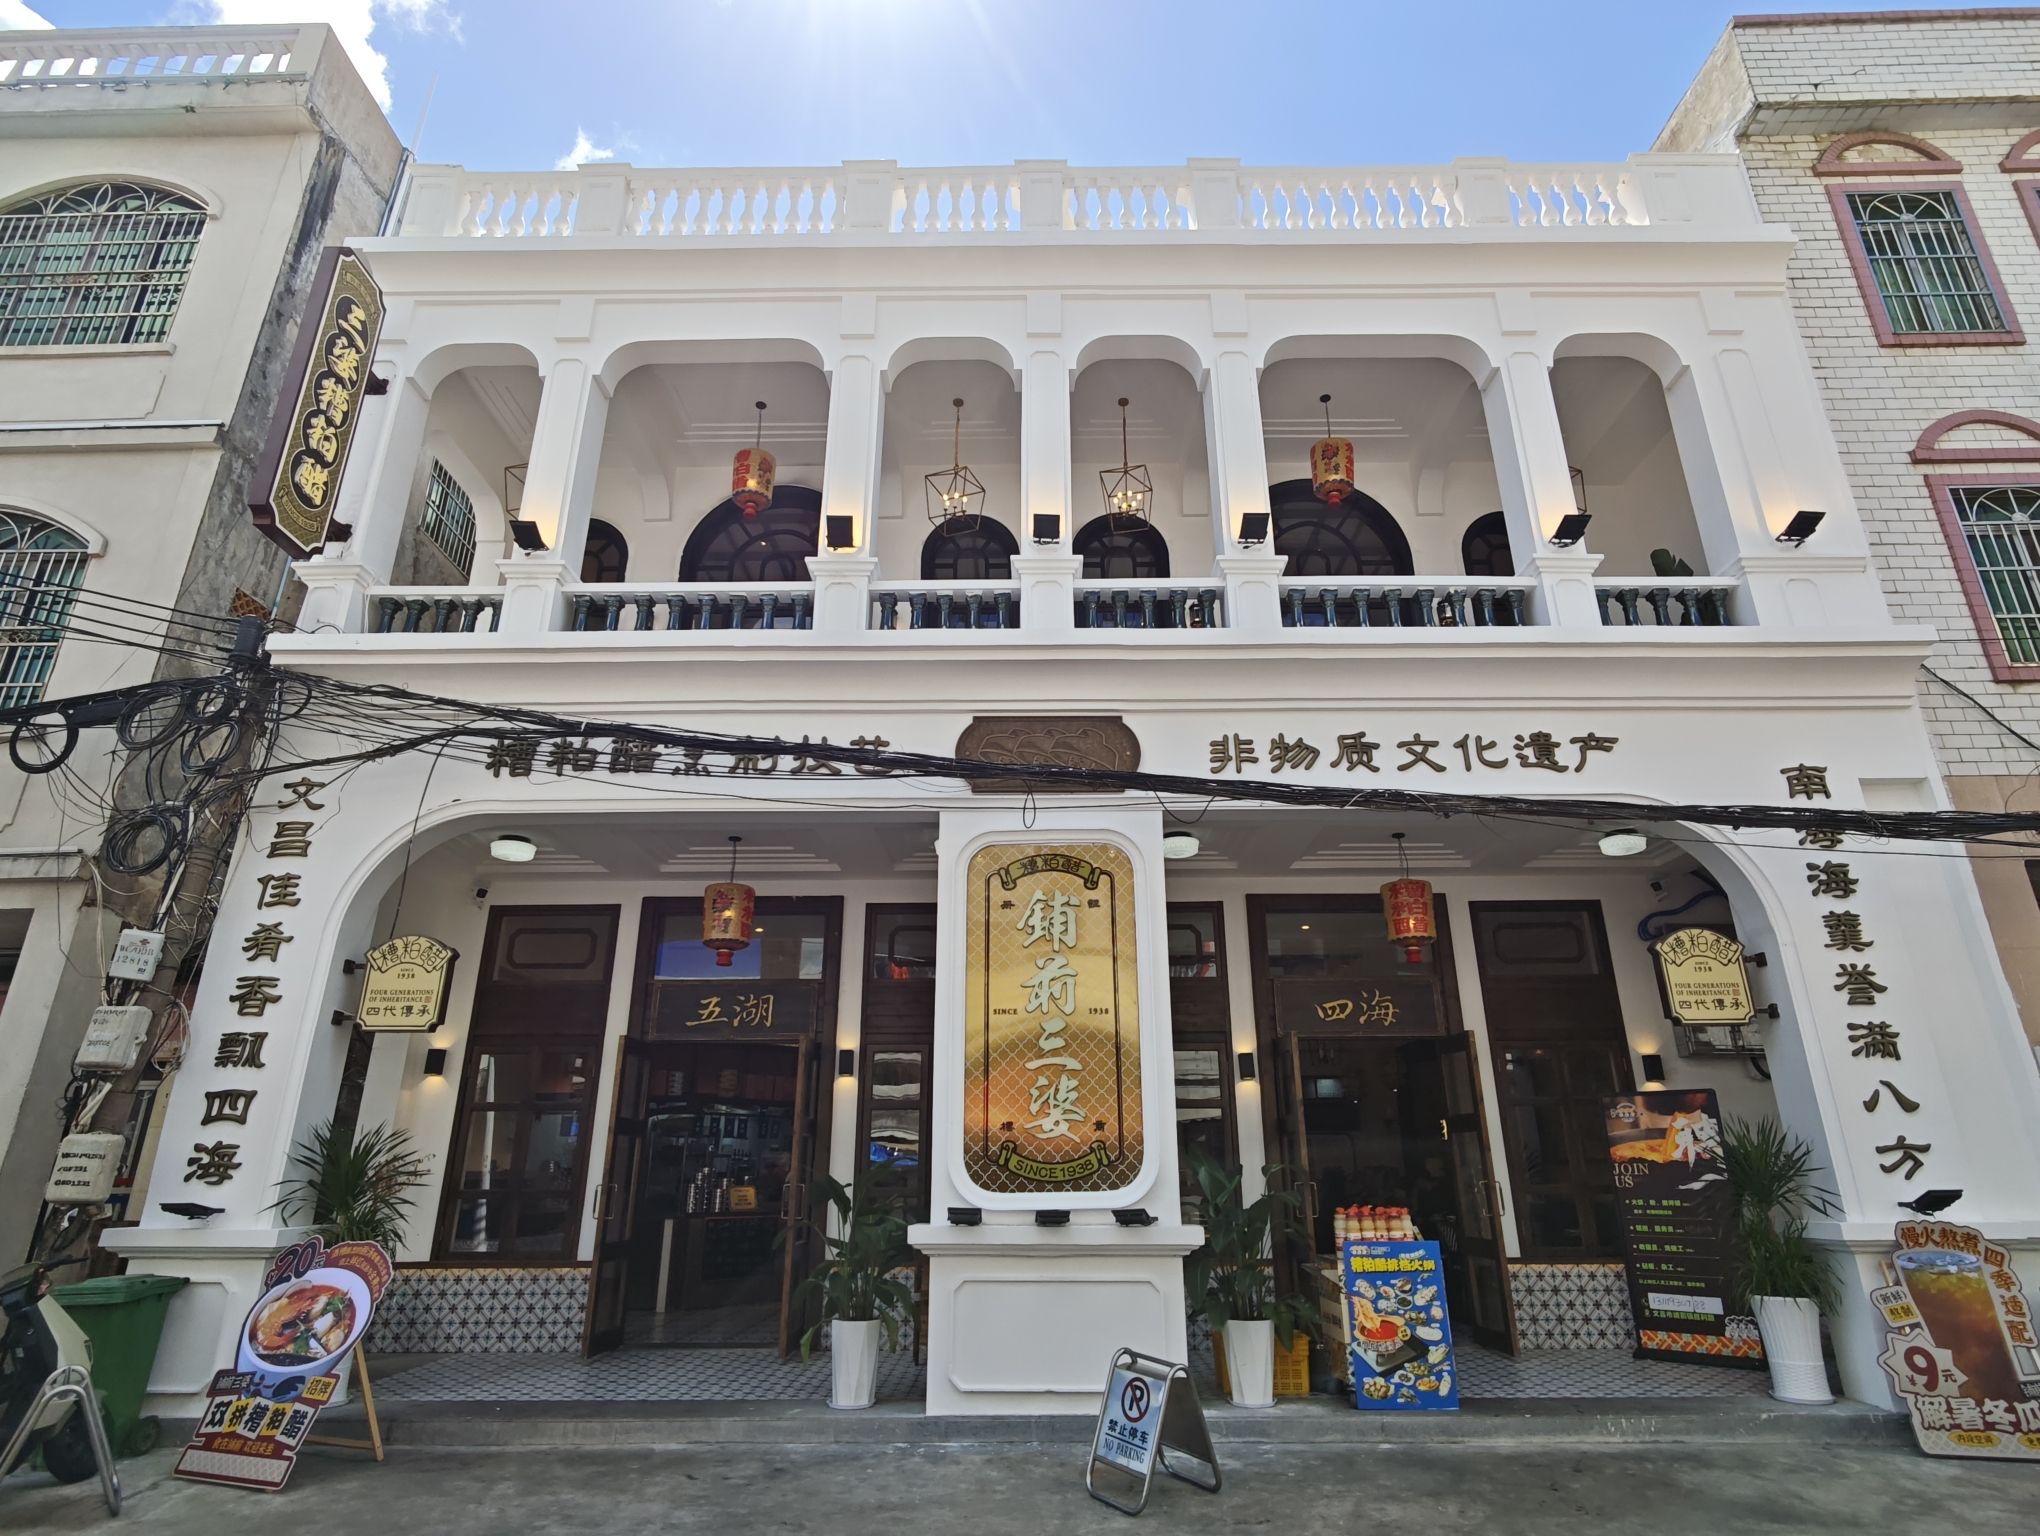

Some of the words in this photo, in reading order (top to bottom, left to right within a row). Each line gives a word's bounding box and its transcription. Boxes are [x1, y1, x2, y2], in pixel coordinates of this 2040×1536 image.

[685, 993, 775, 1029] 五湖
[993, 1008, 1018, 1016] SINCE
[1088, 1007, 1109, 1015] 1938
[1314, 988, 1400, 1027] 四海
[1013, 1159, 1059, 1180] SINCE
[1060, 1159, 1095, 1179] 1938
[1612, 1162, 1649, 1176] JOIN
[1614, 1175, 1634, 1189] US
[1900, 1226, 1983, 1257] 慢火熬煮
[304, 1377, 332, 1397] 招牌
[1106, 1418, 1150, 1446] 禁止停车
[1102, 1438, 1115, 1451] NO
[1115, 1439, 1145, 1465] PARKING
